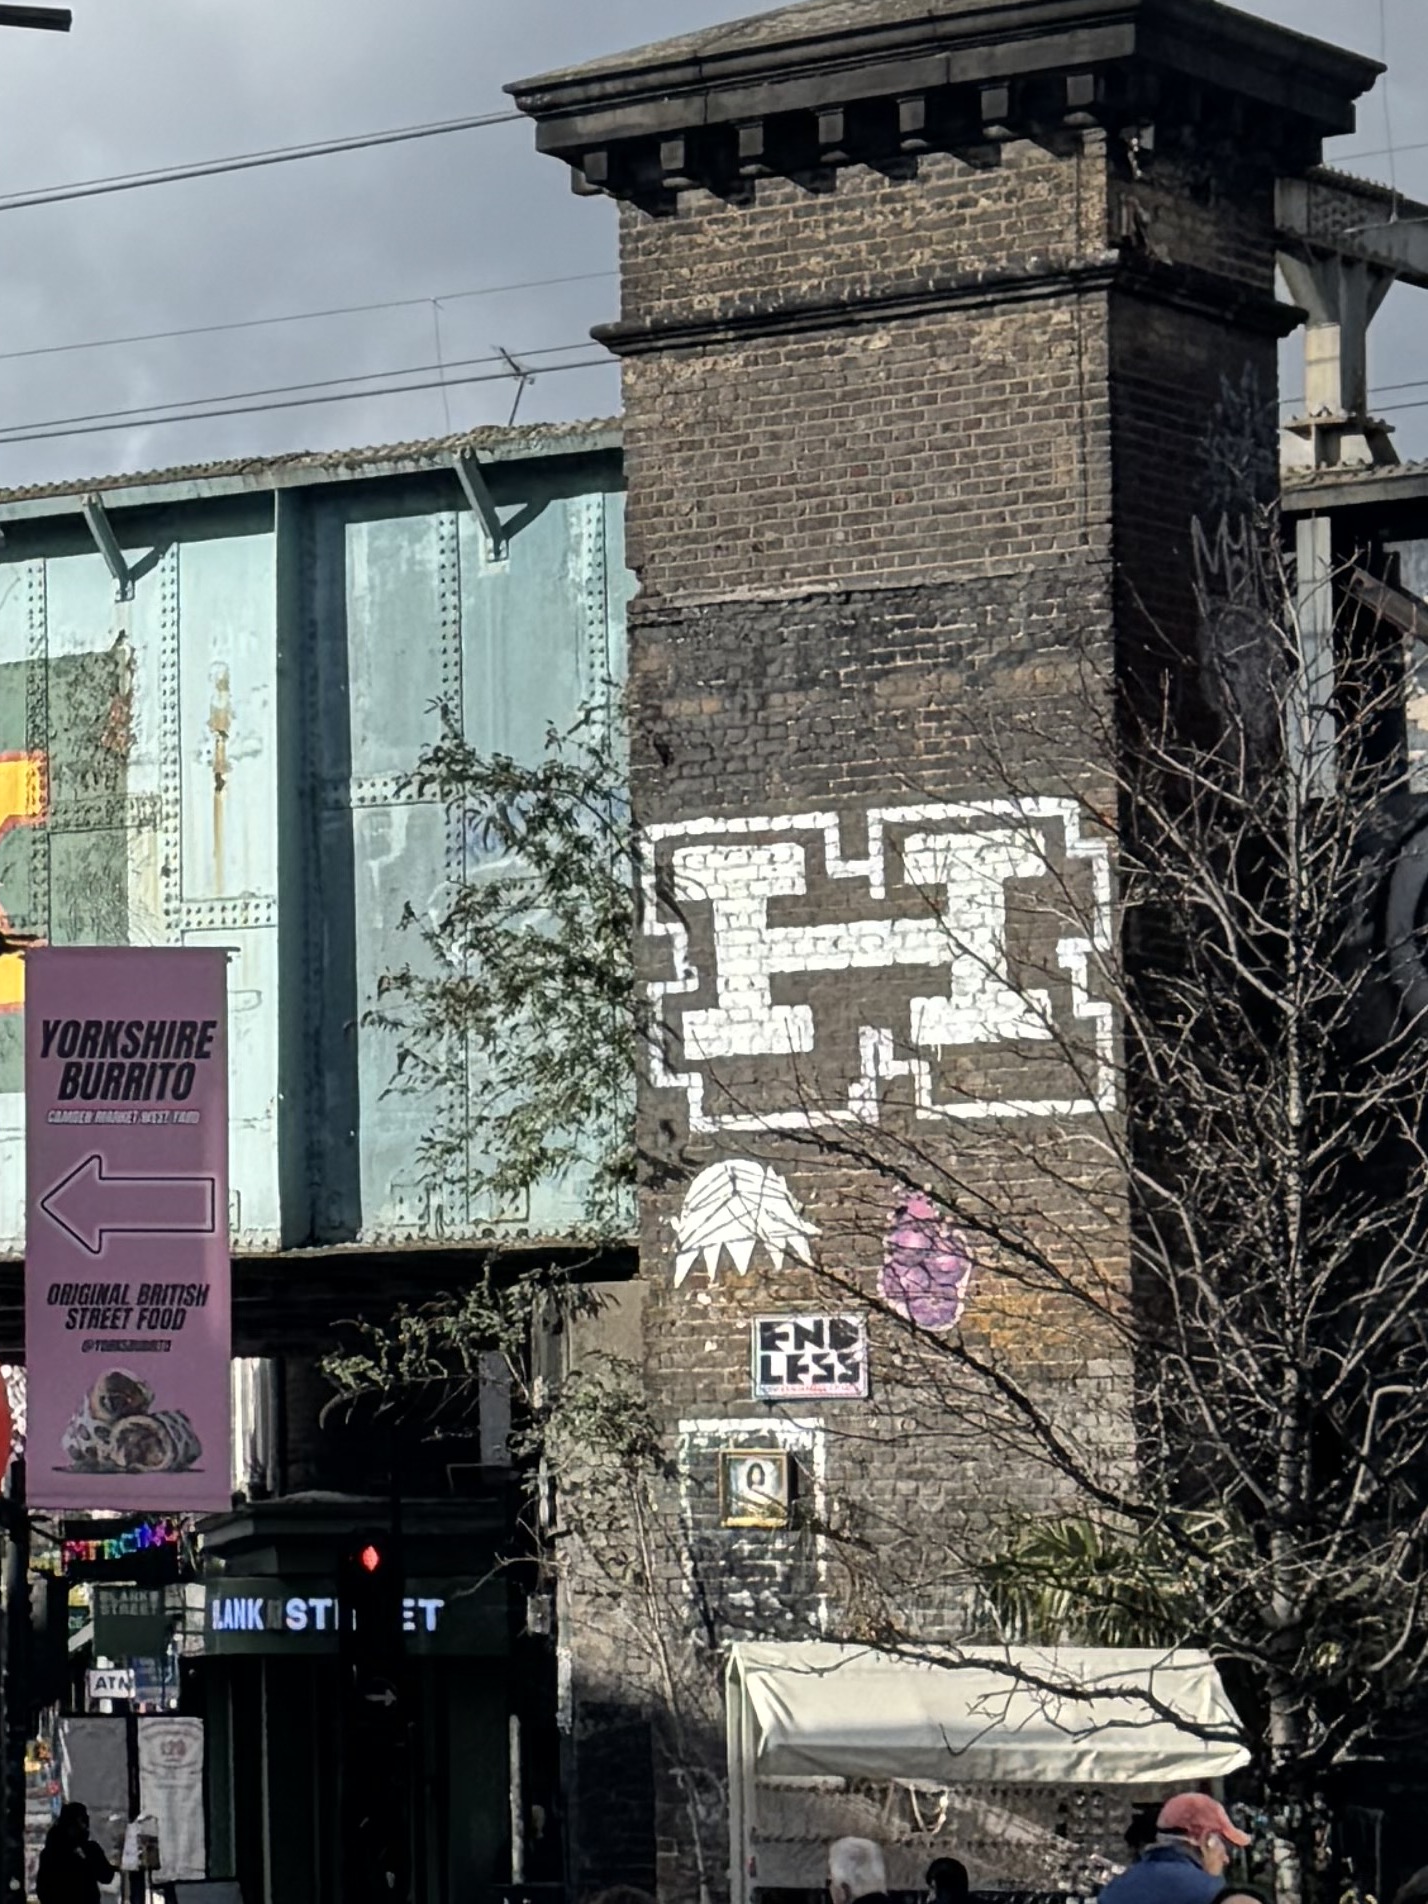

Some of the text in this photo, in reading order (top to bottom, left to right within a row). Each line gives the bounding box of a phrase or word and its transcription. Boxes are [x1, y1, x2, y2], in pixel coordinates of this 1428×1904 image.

[41, 1020, 217, 1059] YORKSHIRE
[58, 1061, 197, 1101] BURRITO
[46, 1283, 209, 1307] ORIGINAL BRITISH
[65, 1307, 187, 1331] STREET FOOD
[285, 1598, 445, 1631] STET
